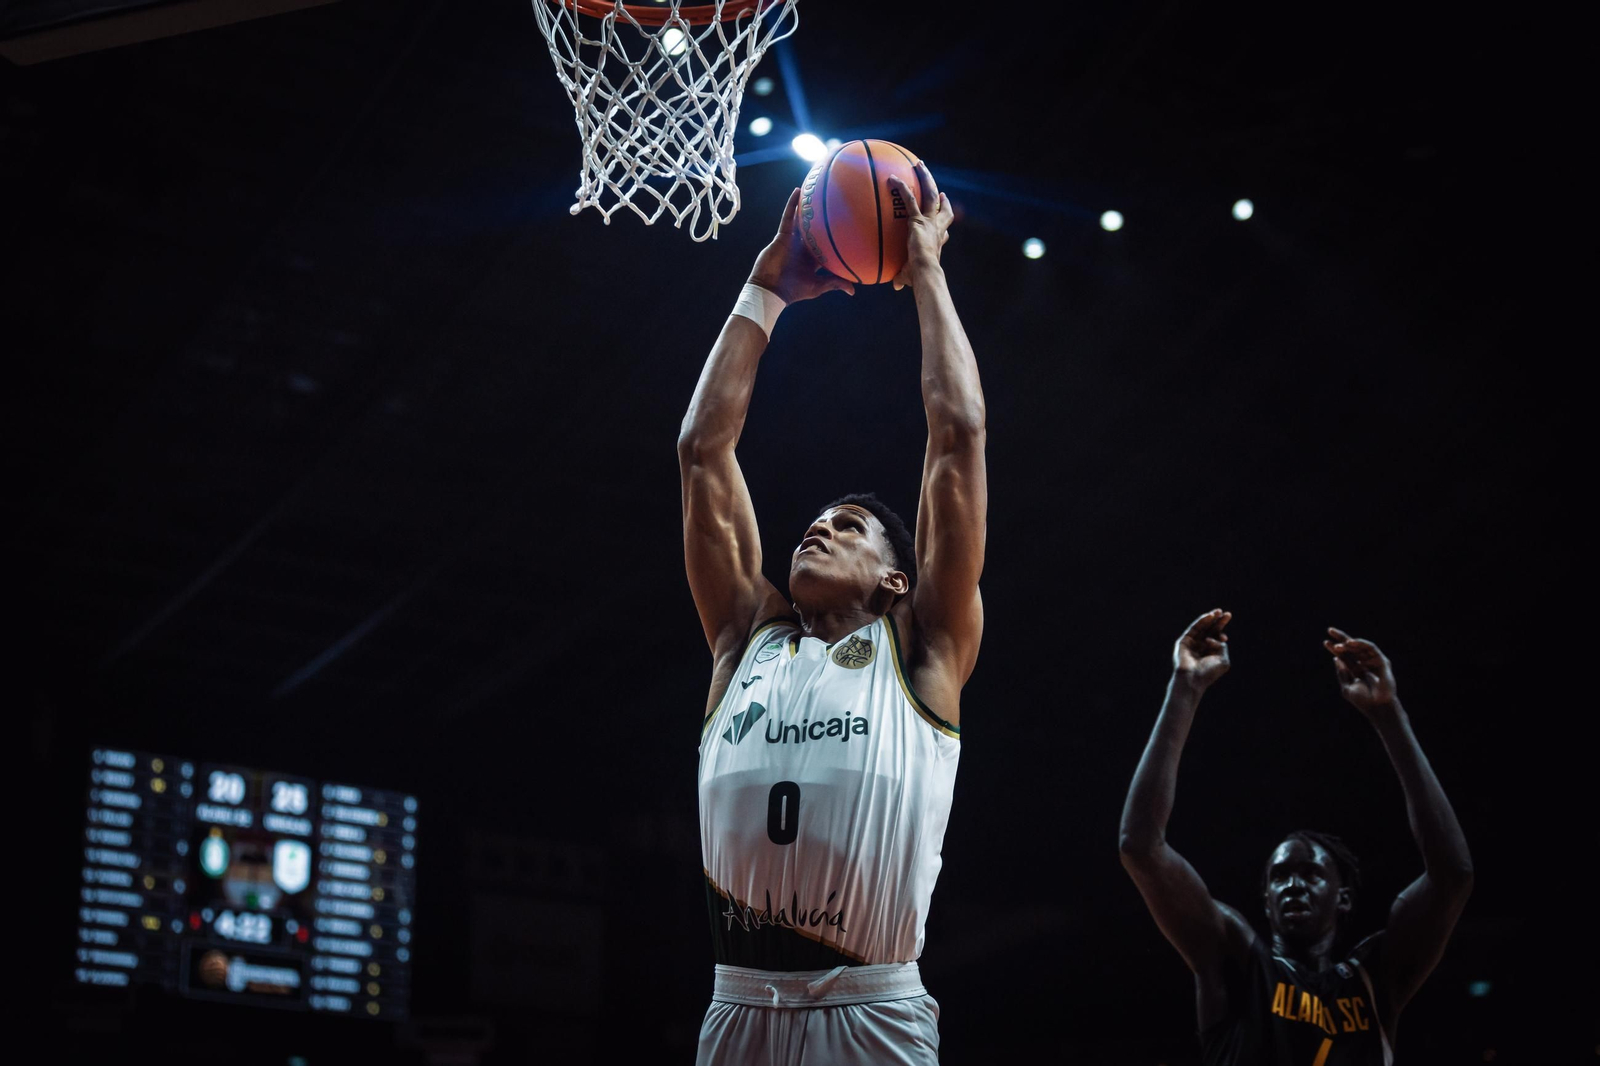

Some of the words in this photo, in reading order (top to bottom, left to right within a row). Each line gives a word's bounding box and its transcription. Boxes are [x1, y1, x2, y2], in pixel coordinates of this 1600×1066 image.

[764, 710, 869, 744] Unicaja
[767, 780, 801, 846] 0
[722, 889, 847, 932] Andalucía
[1335, 996, 1370, 1033] SC
